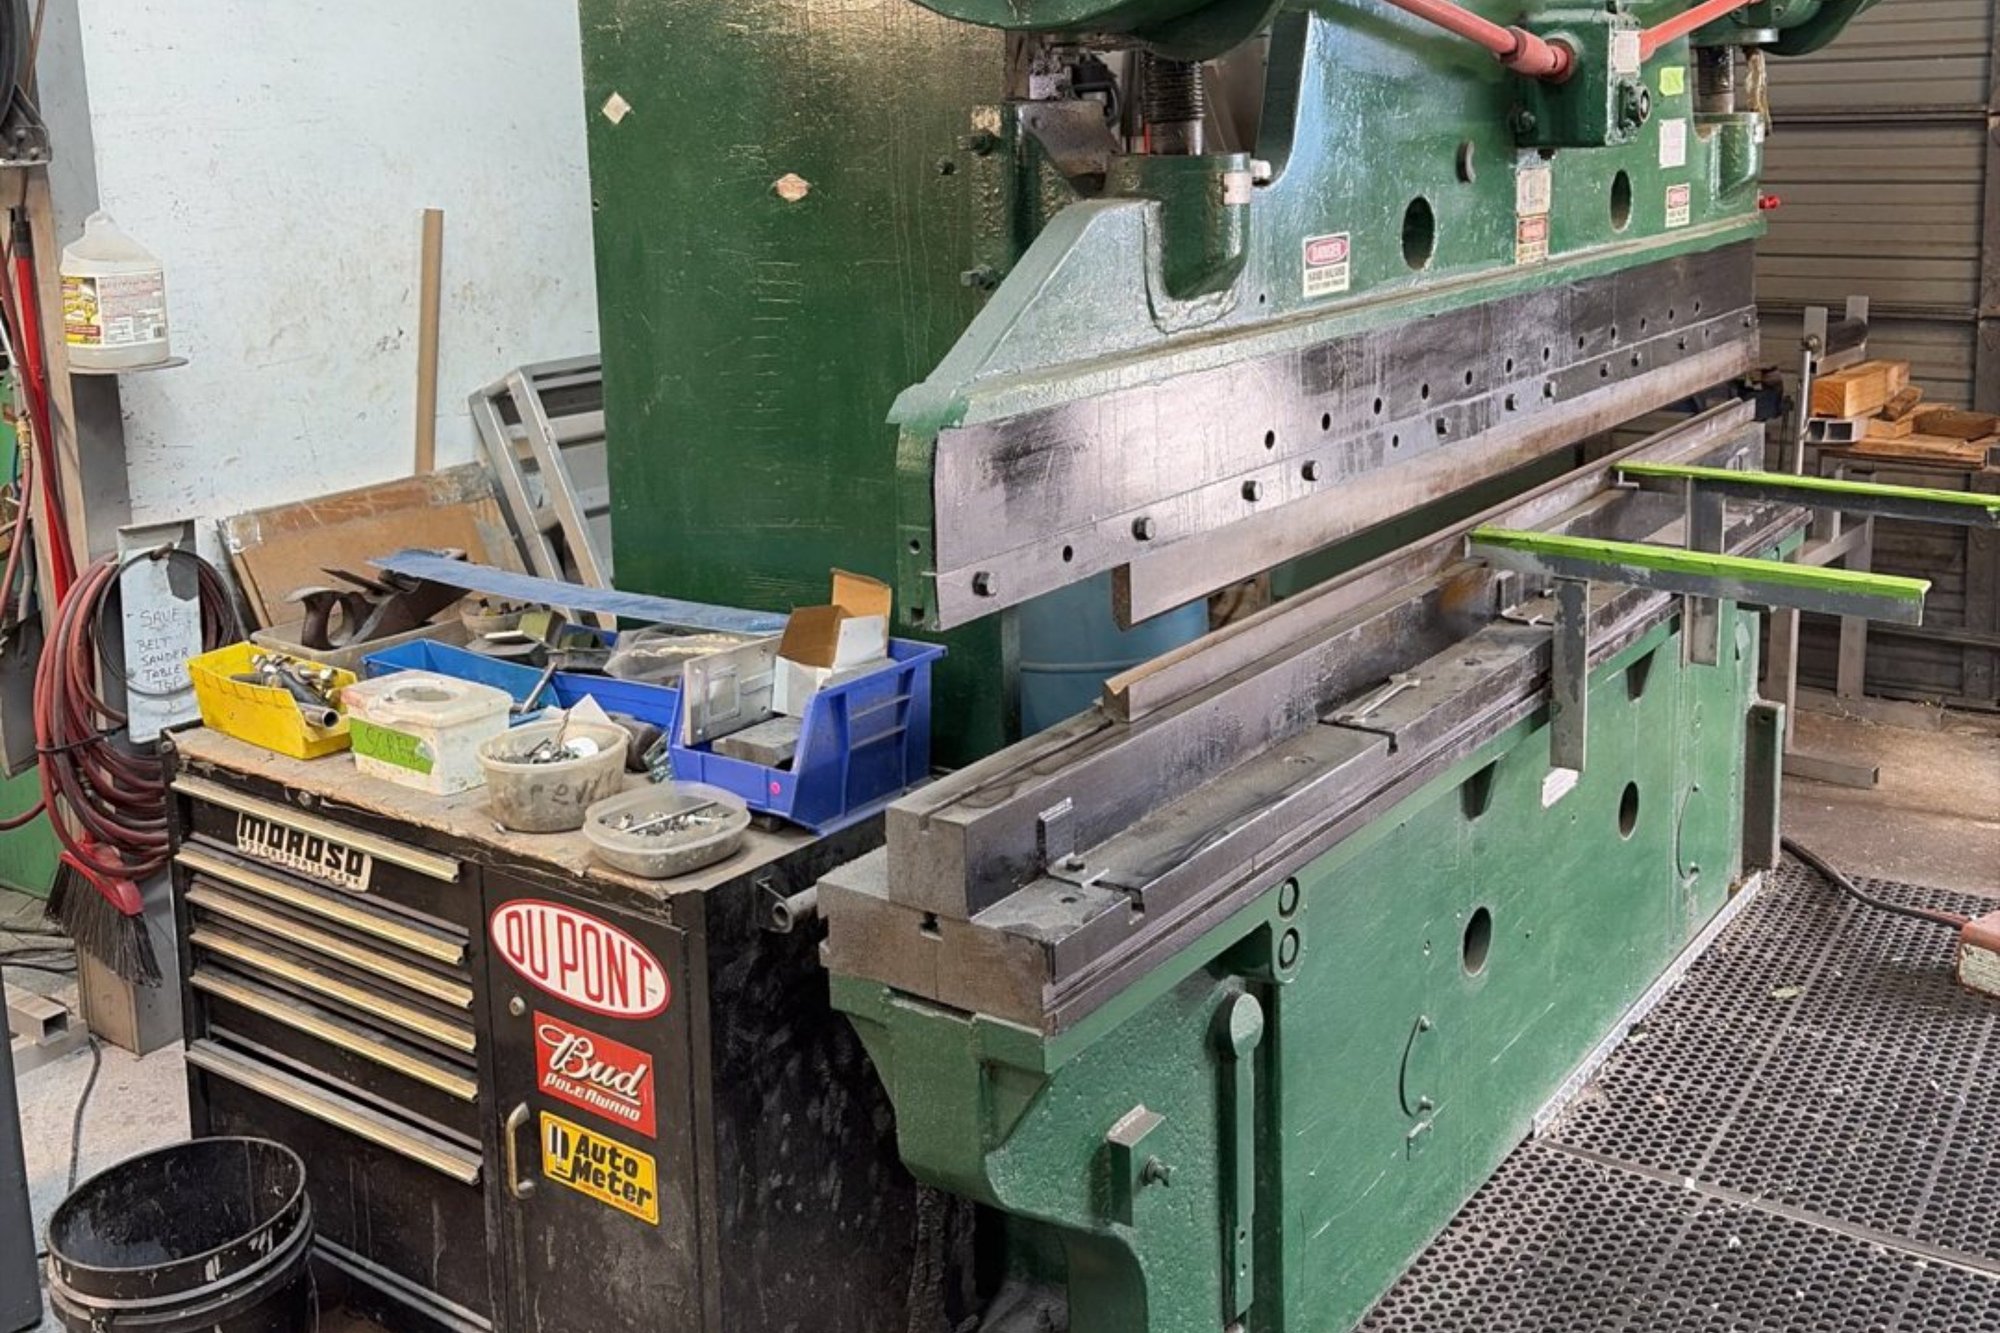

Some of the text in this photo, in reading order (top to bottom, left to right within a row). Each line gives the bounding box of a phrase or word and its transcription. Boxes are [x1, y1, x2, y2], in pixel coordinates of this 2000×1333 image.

[139, 608, 179, 626] SAVE
[136, 637, 170, 653] BELT
[141, 647, 188, 667] SANDER
[143, 664, 182, 682] TABLE
[239, 814, 364, 878] MOROSO
[538, 1024, 648, 1096] Bud
[543, 1072, 641, 1121] POLE AWARD
[575, 1133, 638, 1179] Auto
[570, 1156, 653, 1207] Meter
